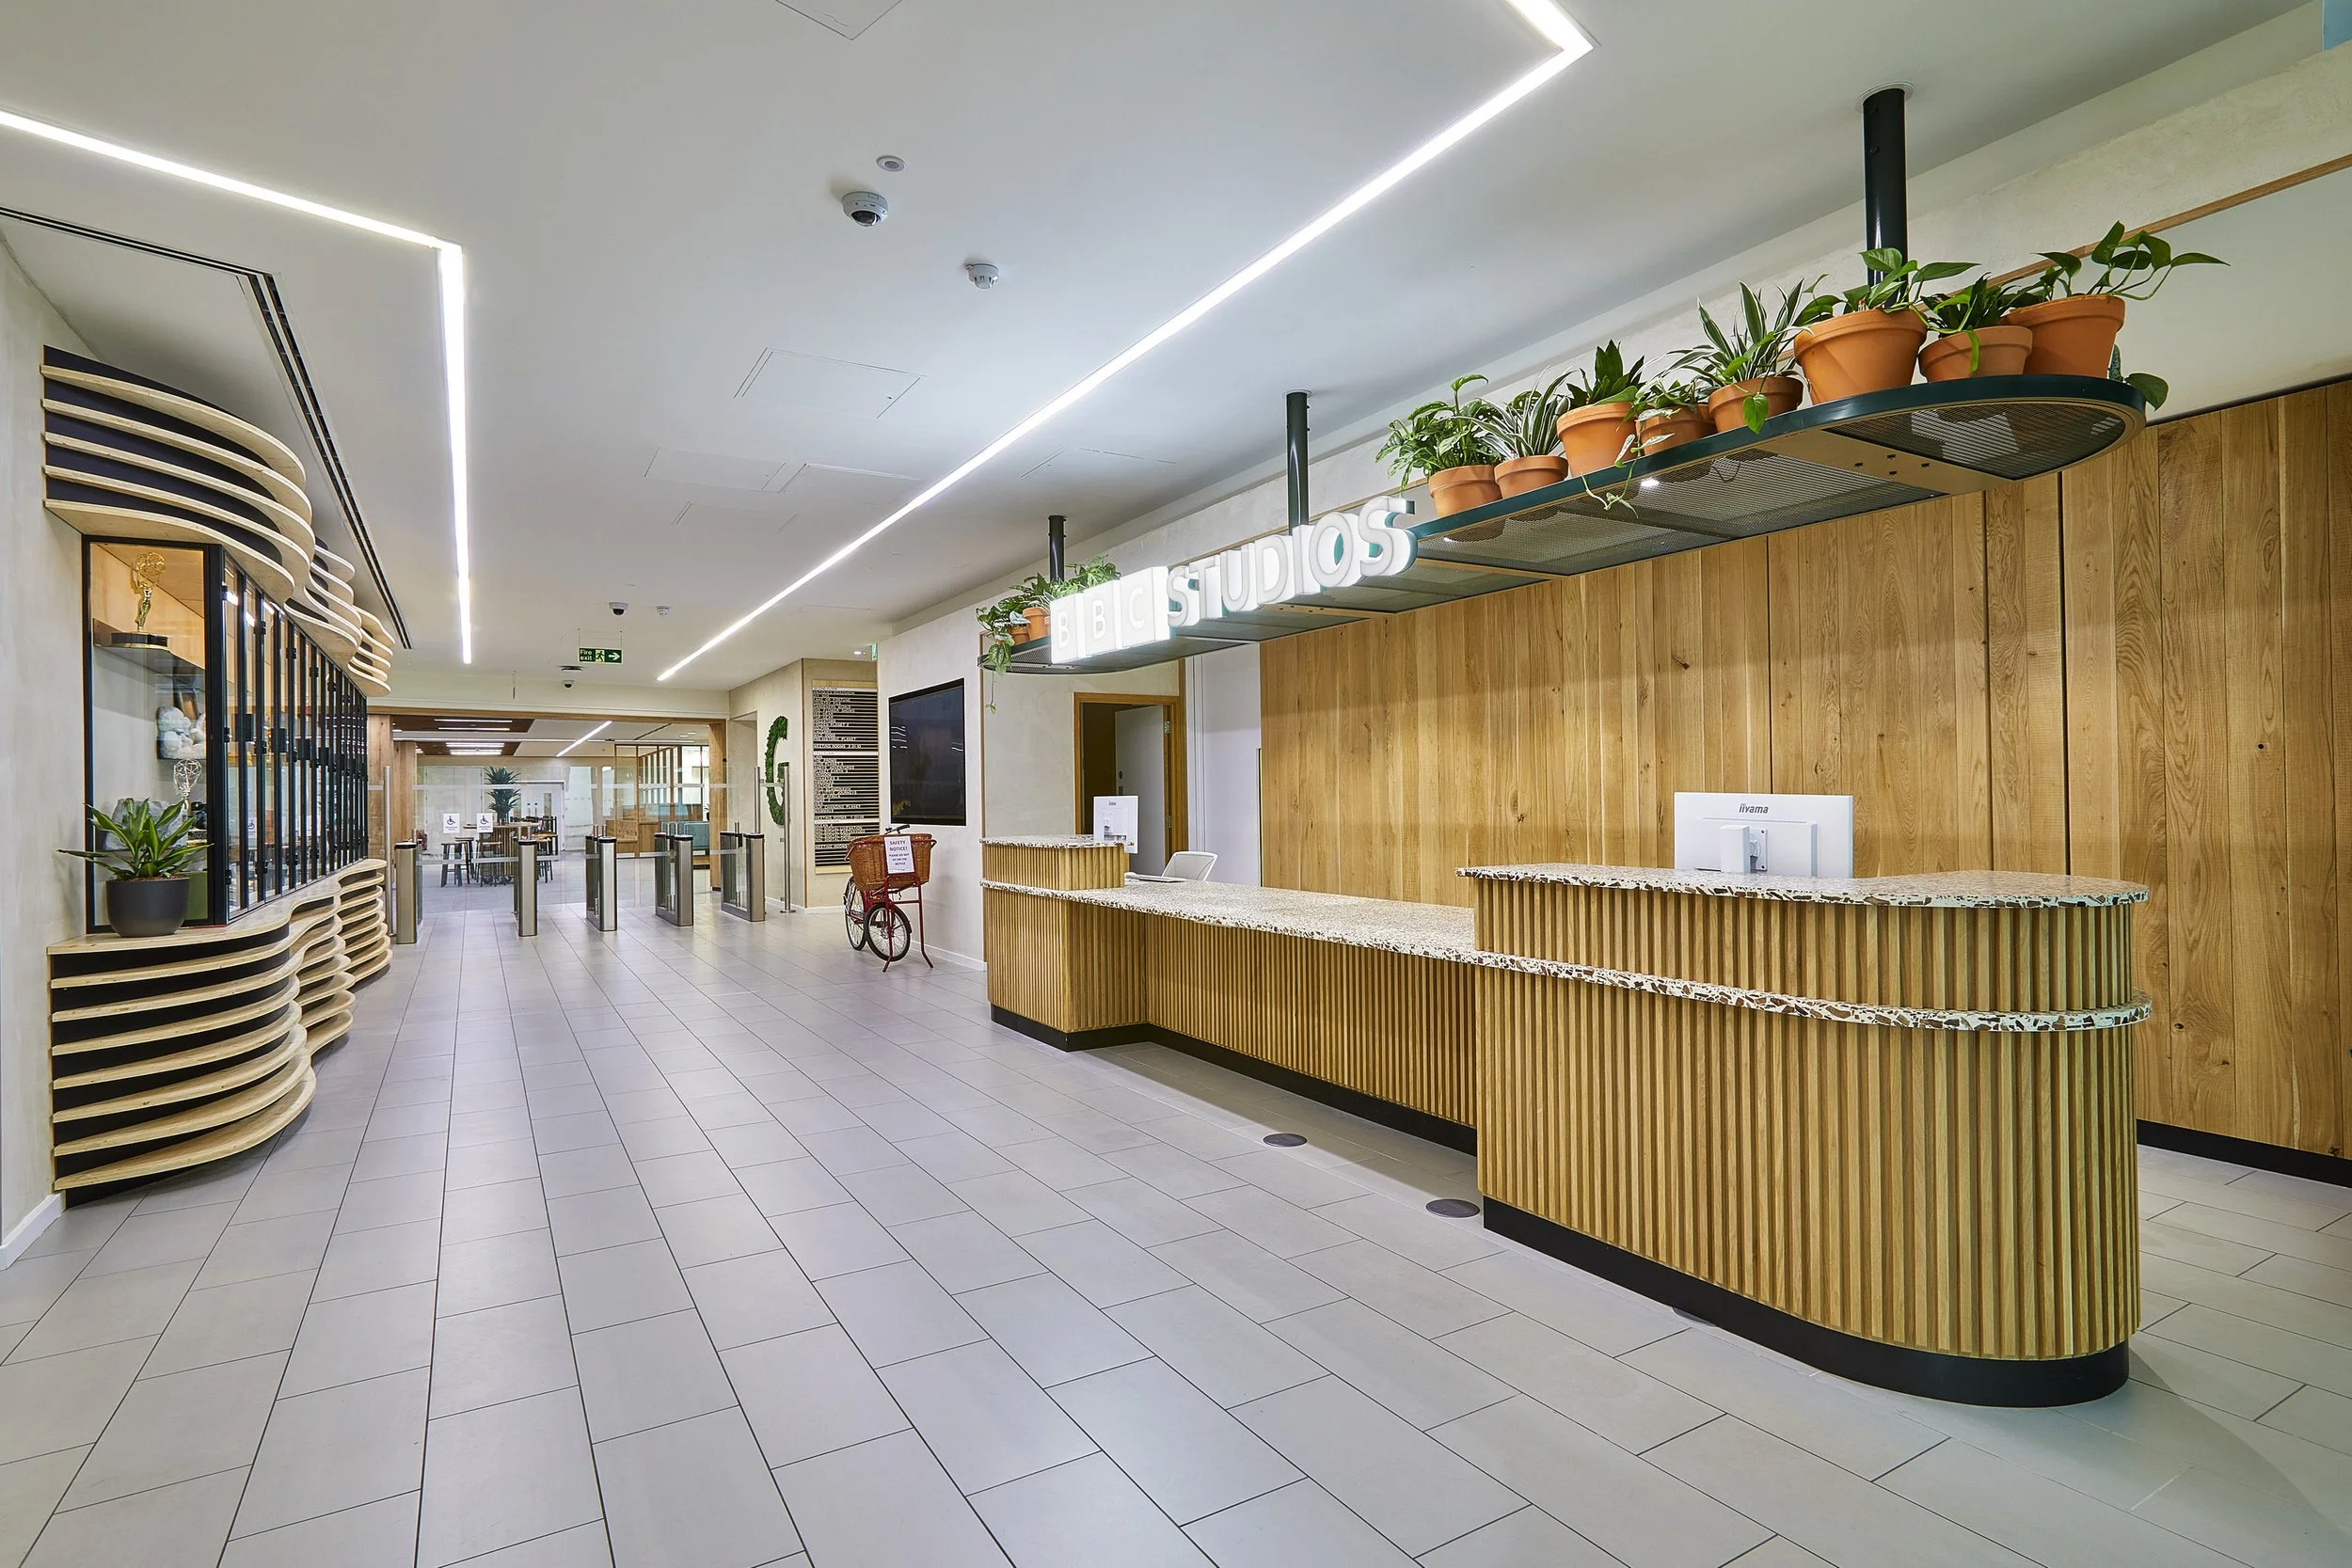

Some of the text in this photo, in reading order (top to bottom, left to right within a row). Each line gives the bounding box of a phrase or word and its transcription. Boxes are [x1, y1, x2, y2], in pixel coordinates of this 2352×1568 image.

[1053, 496, 1418, 658] BBC STUDIOS
[1739, 802, 1770, 815] iiyama
